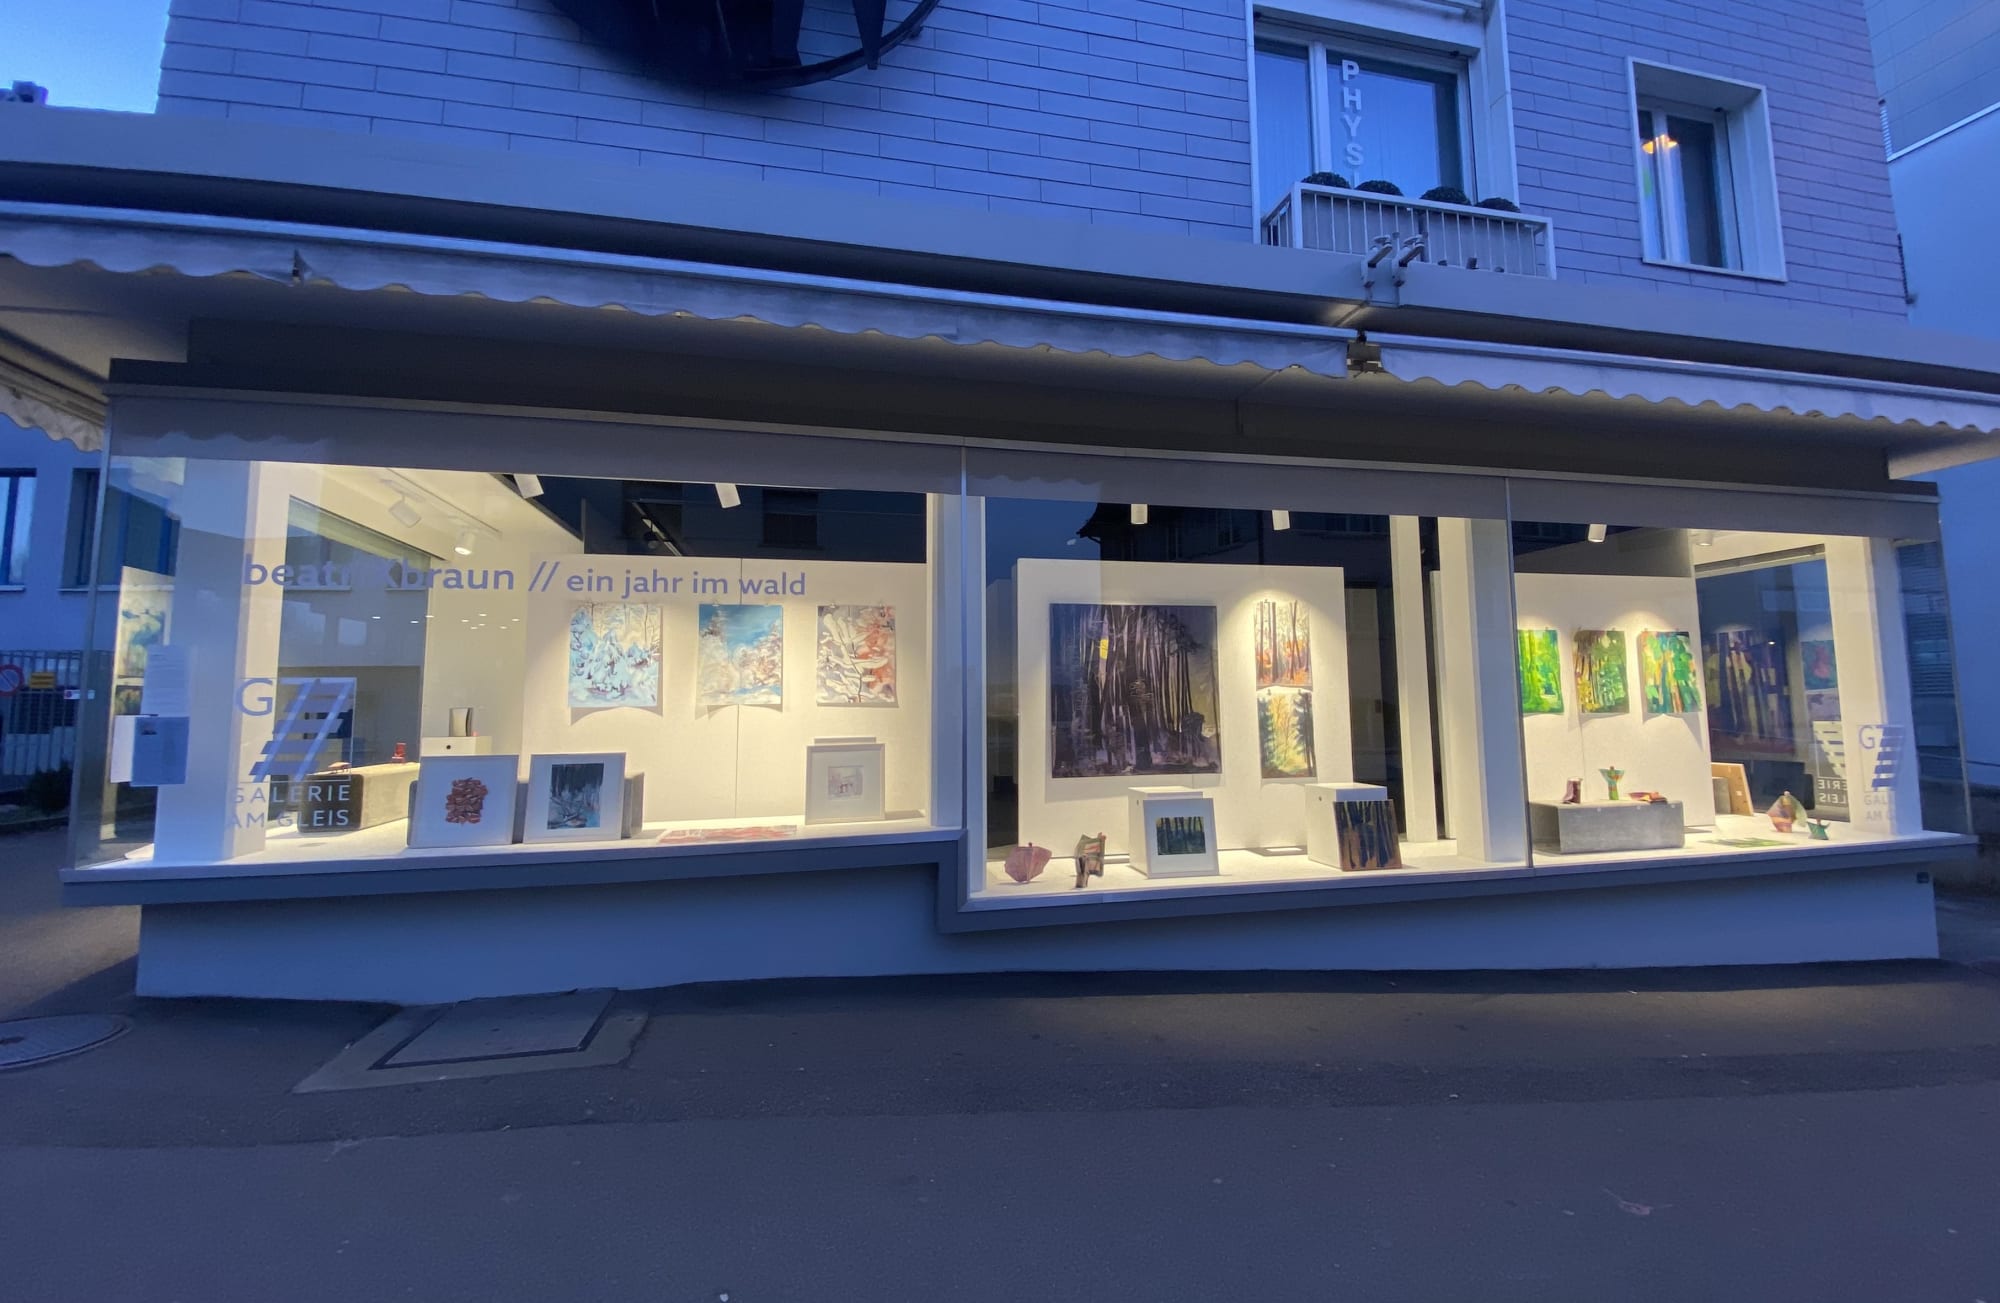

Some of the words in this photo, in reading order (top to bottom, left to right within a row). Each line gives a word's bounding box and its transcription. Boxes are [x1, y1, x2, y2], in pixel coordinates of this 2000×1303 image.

[567, 569, 614, 592] ein
[621, 569, 683, 599] jahr
[693, 571, 729, 594] im
[739, 572, 806, 595] wald
[233, 785, 351, 803] GALERIE
[228, 812, 265, 828] AM
[277, 810, 349, 827] GLEIS
